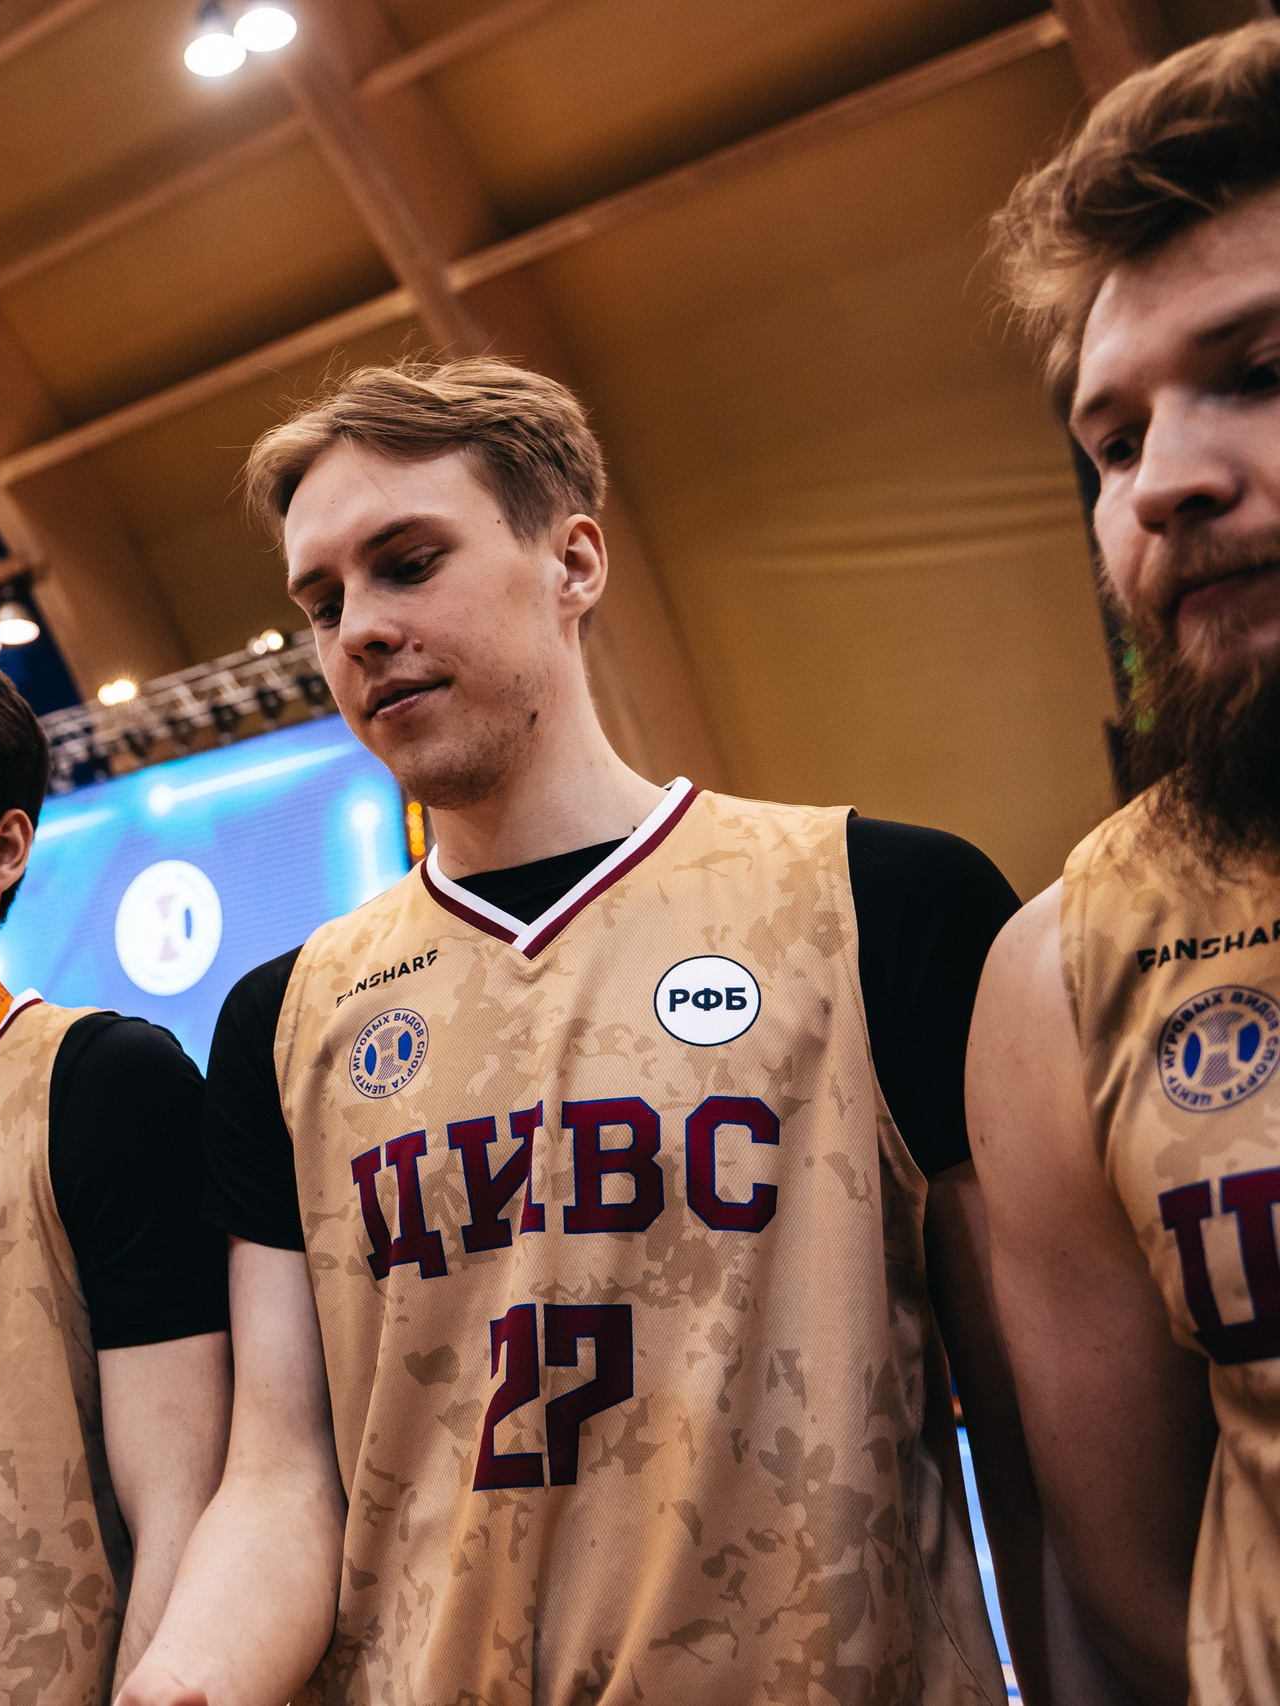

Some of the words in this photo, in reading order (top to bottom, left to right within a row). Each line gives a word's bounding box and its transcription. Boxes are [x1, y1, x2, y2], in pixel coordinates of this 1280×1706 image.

[393, 1012, 425, 1038] ВИДОВ
[669, 987, 747, 1012] РФБ
[1230, 991, 1279, 1032] ВИДОВ
[352, 1015, 391, 1071] ИГРОВЫХ
[1164, 992, 1223, 1069] ИГРОВЫХ
[355, 1074, 386, 1094] ЦЕНТР
[391, 1040, 425, 1089] СПОРТА
[1222, 1035, 1279, 1101] СПОРТА
[350, 1095, 780, 1281] ЦИВС
[472, 1303, 634, 1492] 27
